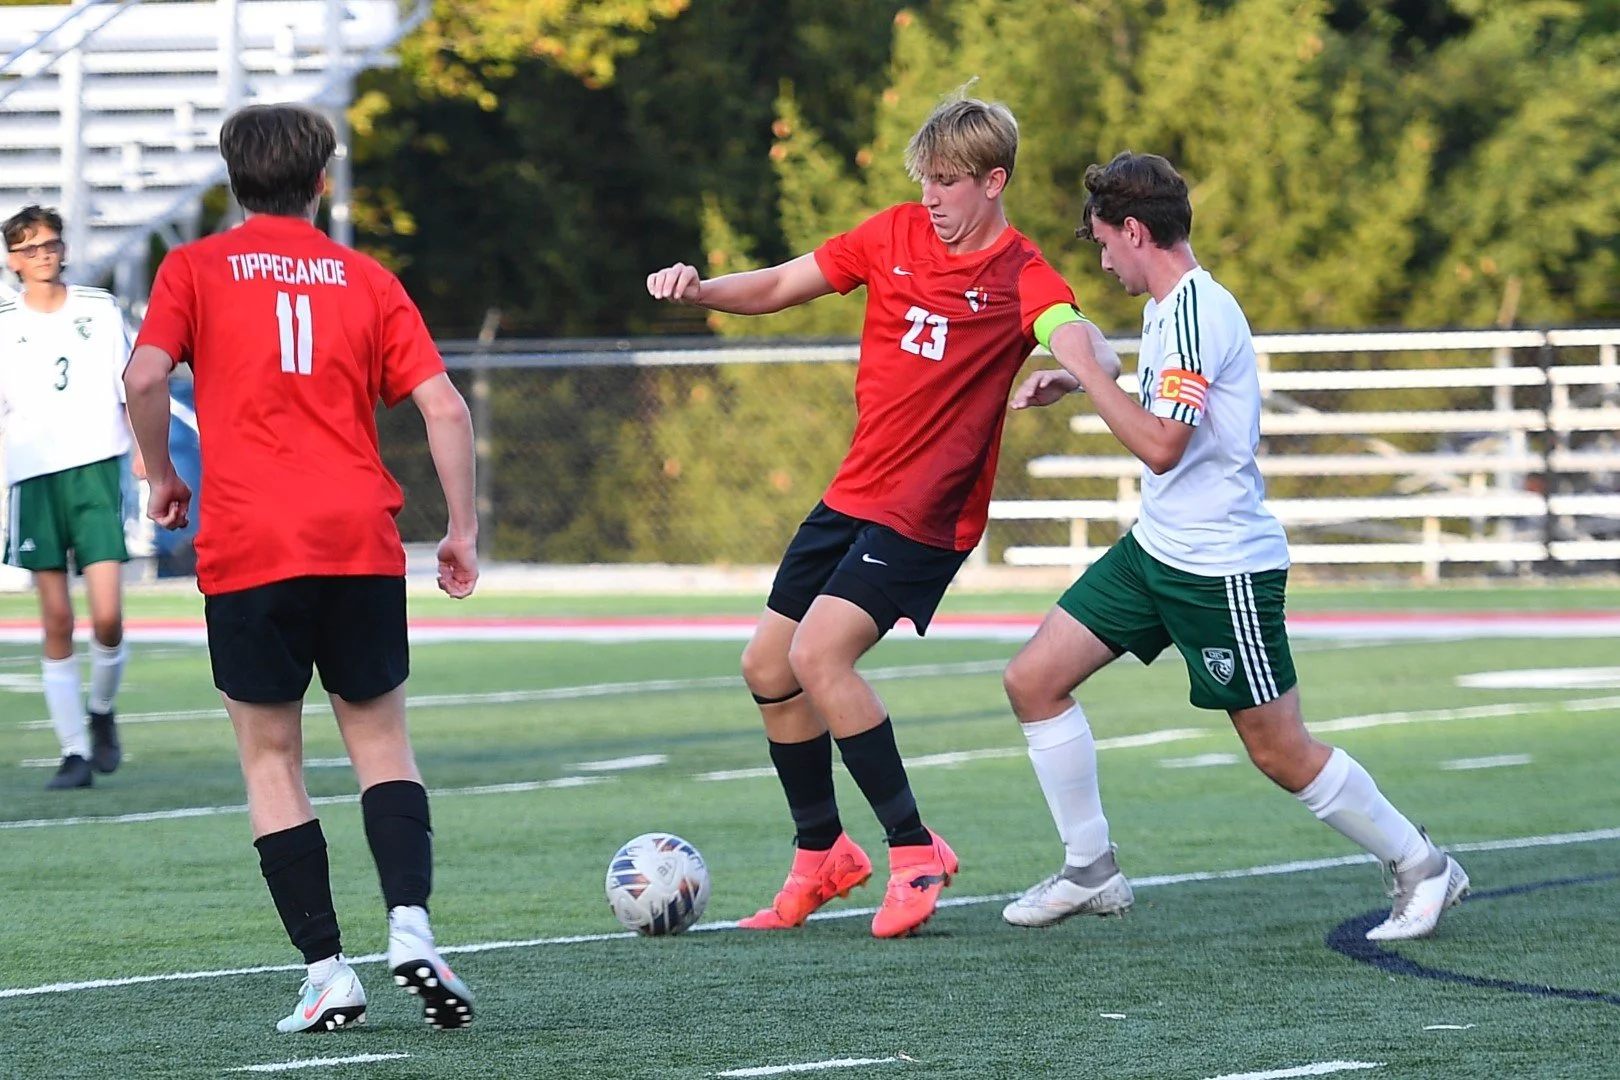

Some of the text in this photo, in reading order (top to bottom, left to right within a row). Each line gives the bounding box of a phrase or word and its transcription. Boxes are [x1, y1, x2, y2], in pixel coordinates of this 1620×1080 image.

[226, 252, 348, 287] TIPPECANOE
[275, 290, 313, 375] 11
[900, 305, 949, 361] 23
[54, 356, 69, 391] 3
[1162, 375, 1181, 398] C
